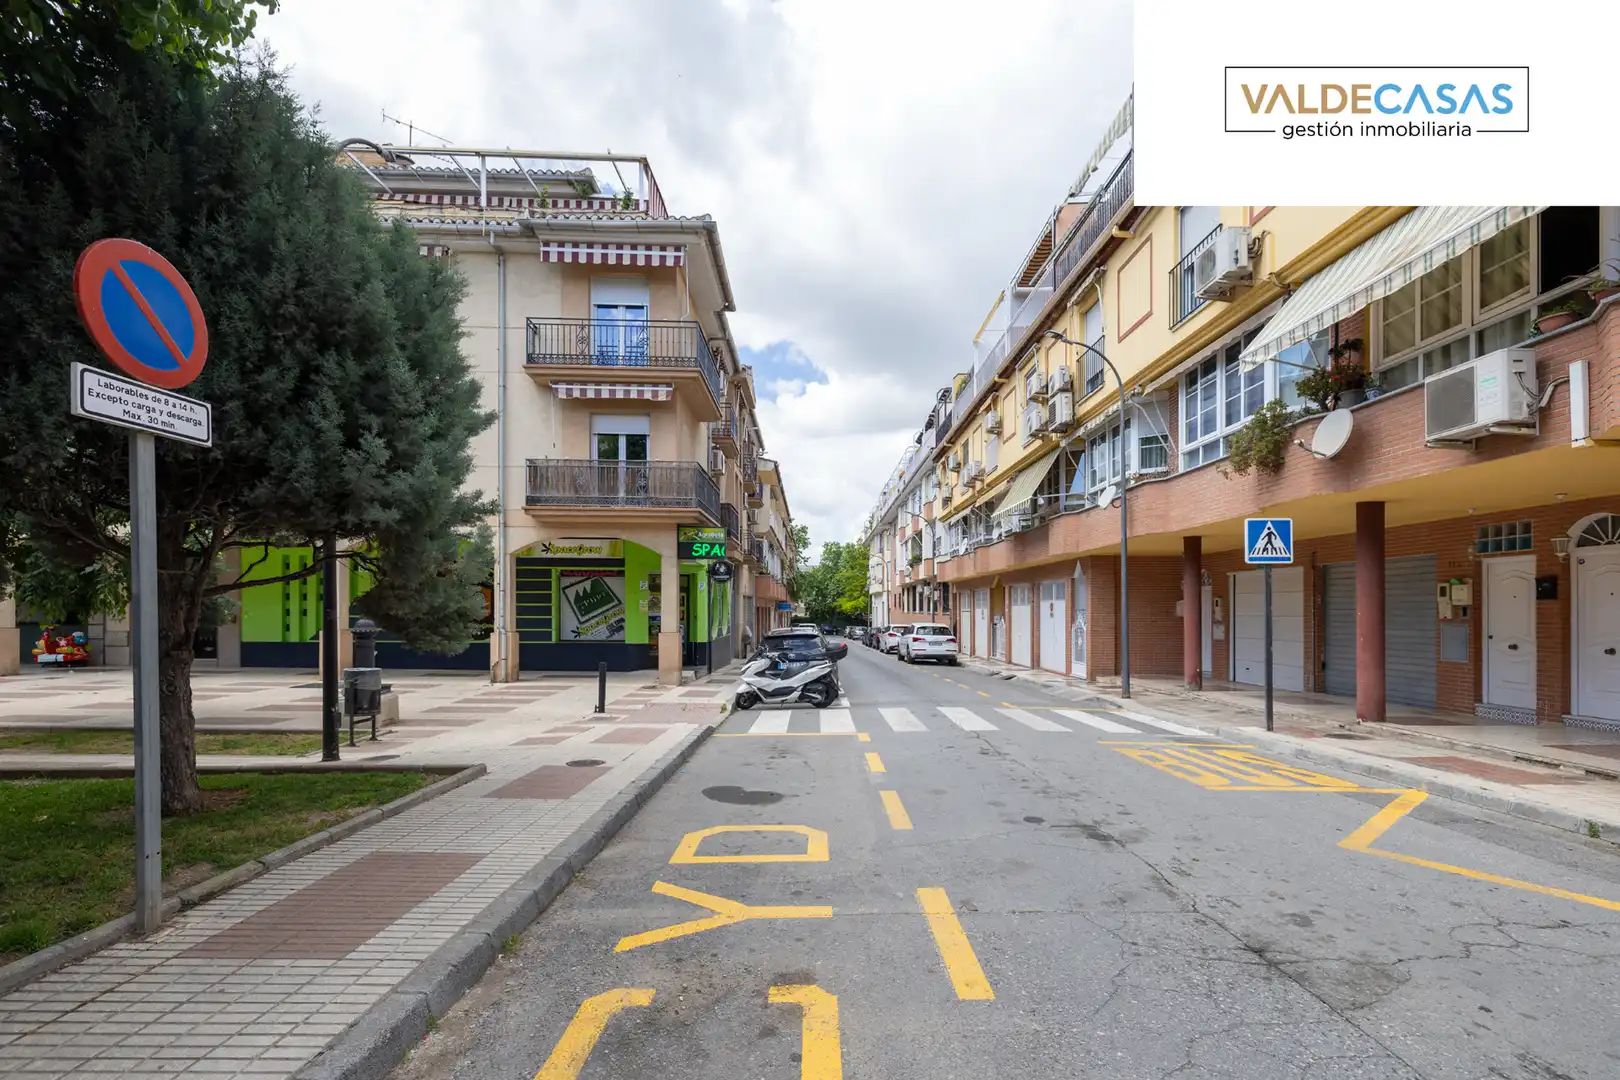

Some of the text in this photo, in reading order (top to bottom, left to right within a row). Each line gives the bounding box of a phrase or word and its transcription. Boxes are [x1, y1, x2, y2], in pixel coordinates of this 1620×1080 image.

[88, 387, 205, 428] Excepto carga y descarga.
[97, 378, 149, 401] Laborables
[151, 393, 162, 404] de
[164, 398, 170, 407] 8
[178, 402, 188, 412] 14
[189, 405, 198, 415] h.
[122, 409, 178, 430] Max. 30 min.
